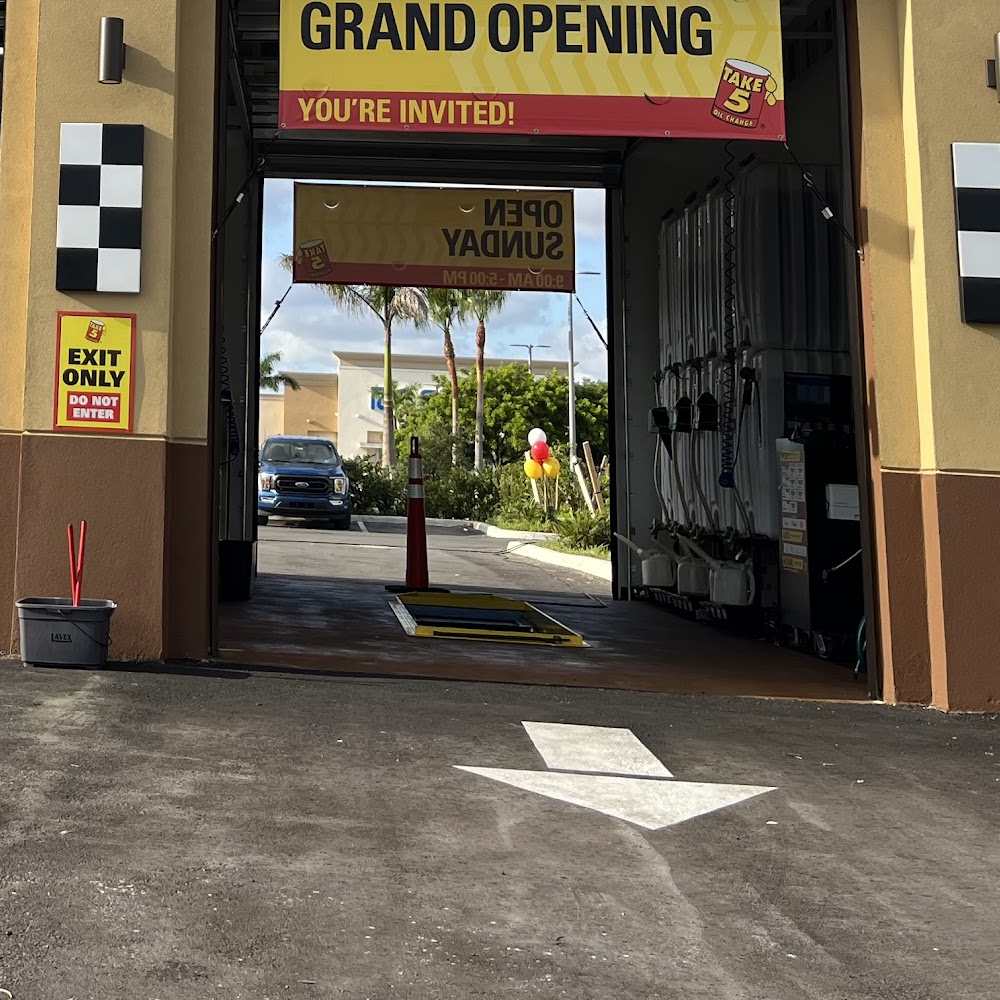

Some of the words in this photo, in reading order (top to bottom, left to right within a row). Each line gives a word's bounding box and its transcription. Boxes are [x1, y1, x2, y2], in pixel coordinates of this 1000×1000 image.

[300, 1, 476, 51] GRAND
[488, 2, 713, 56] OPENING
[721, 66, 764, 93] TAKE
[723, 87, 751, 114] 5
[297, 97, 391, 124] YOU'RE
[400, 98, 515, 126] INVITED!
[713, 109, 723, 119] OIL
[726, 115, 753, 127] CHANGE
[68, 348, 121, 366] EXIT
[62, 368, 126, 387] ONLY
[69, 394, 88, 405] DO
[91, 395, 119, 407] NOT
[73, 408, 114, 419] ENTER
